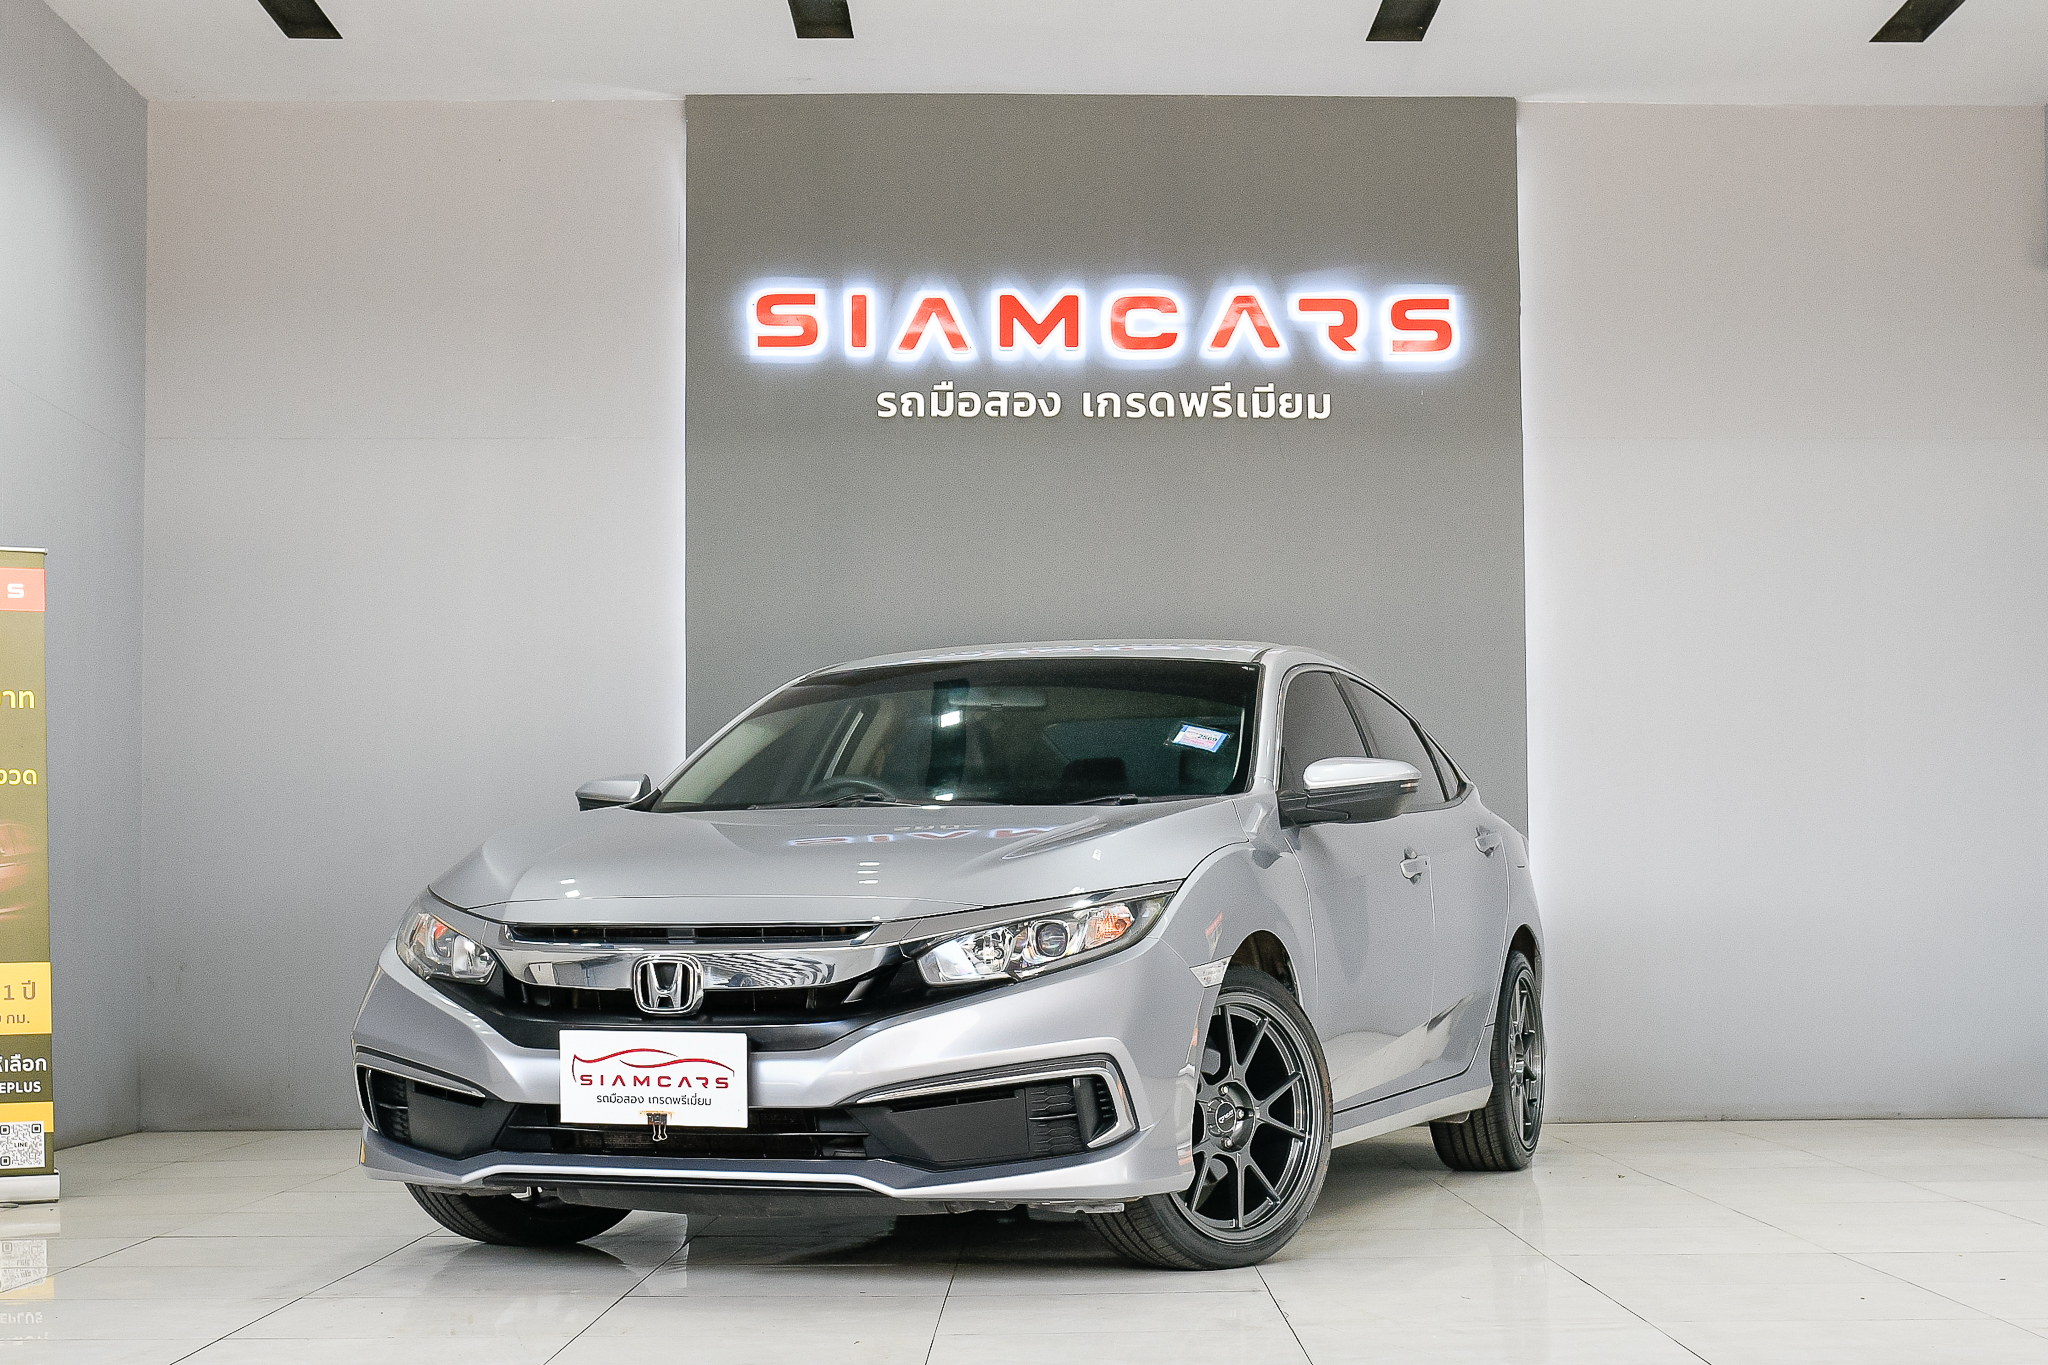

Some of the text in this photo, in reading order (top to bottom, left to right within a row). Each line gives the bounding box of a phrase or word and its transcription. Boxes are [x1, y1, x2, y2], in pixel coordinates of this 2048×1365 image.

[754, 291, 1455, 354] SIAMCARS
[876, 380, 1332, 419] รถมือสอง เกรดพรีเมียม
[21, 979, 36, 1000] ปี
[580, 1074, 729, 1089] SIAMCARS
[596, 1092, 645, 1104] รถมือสอง
